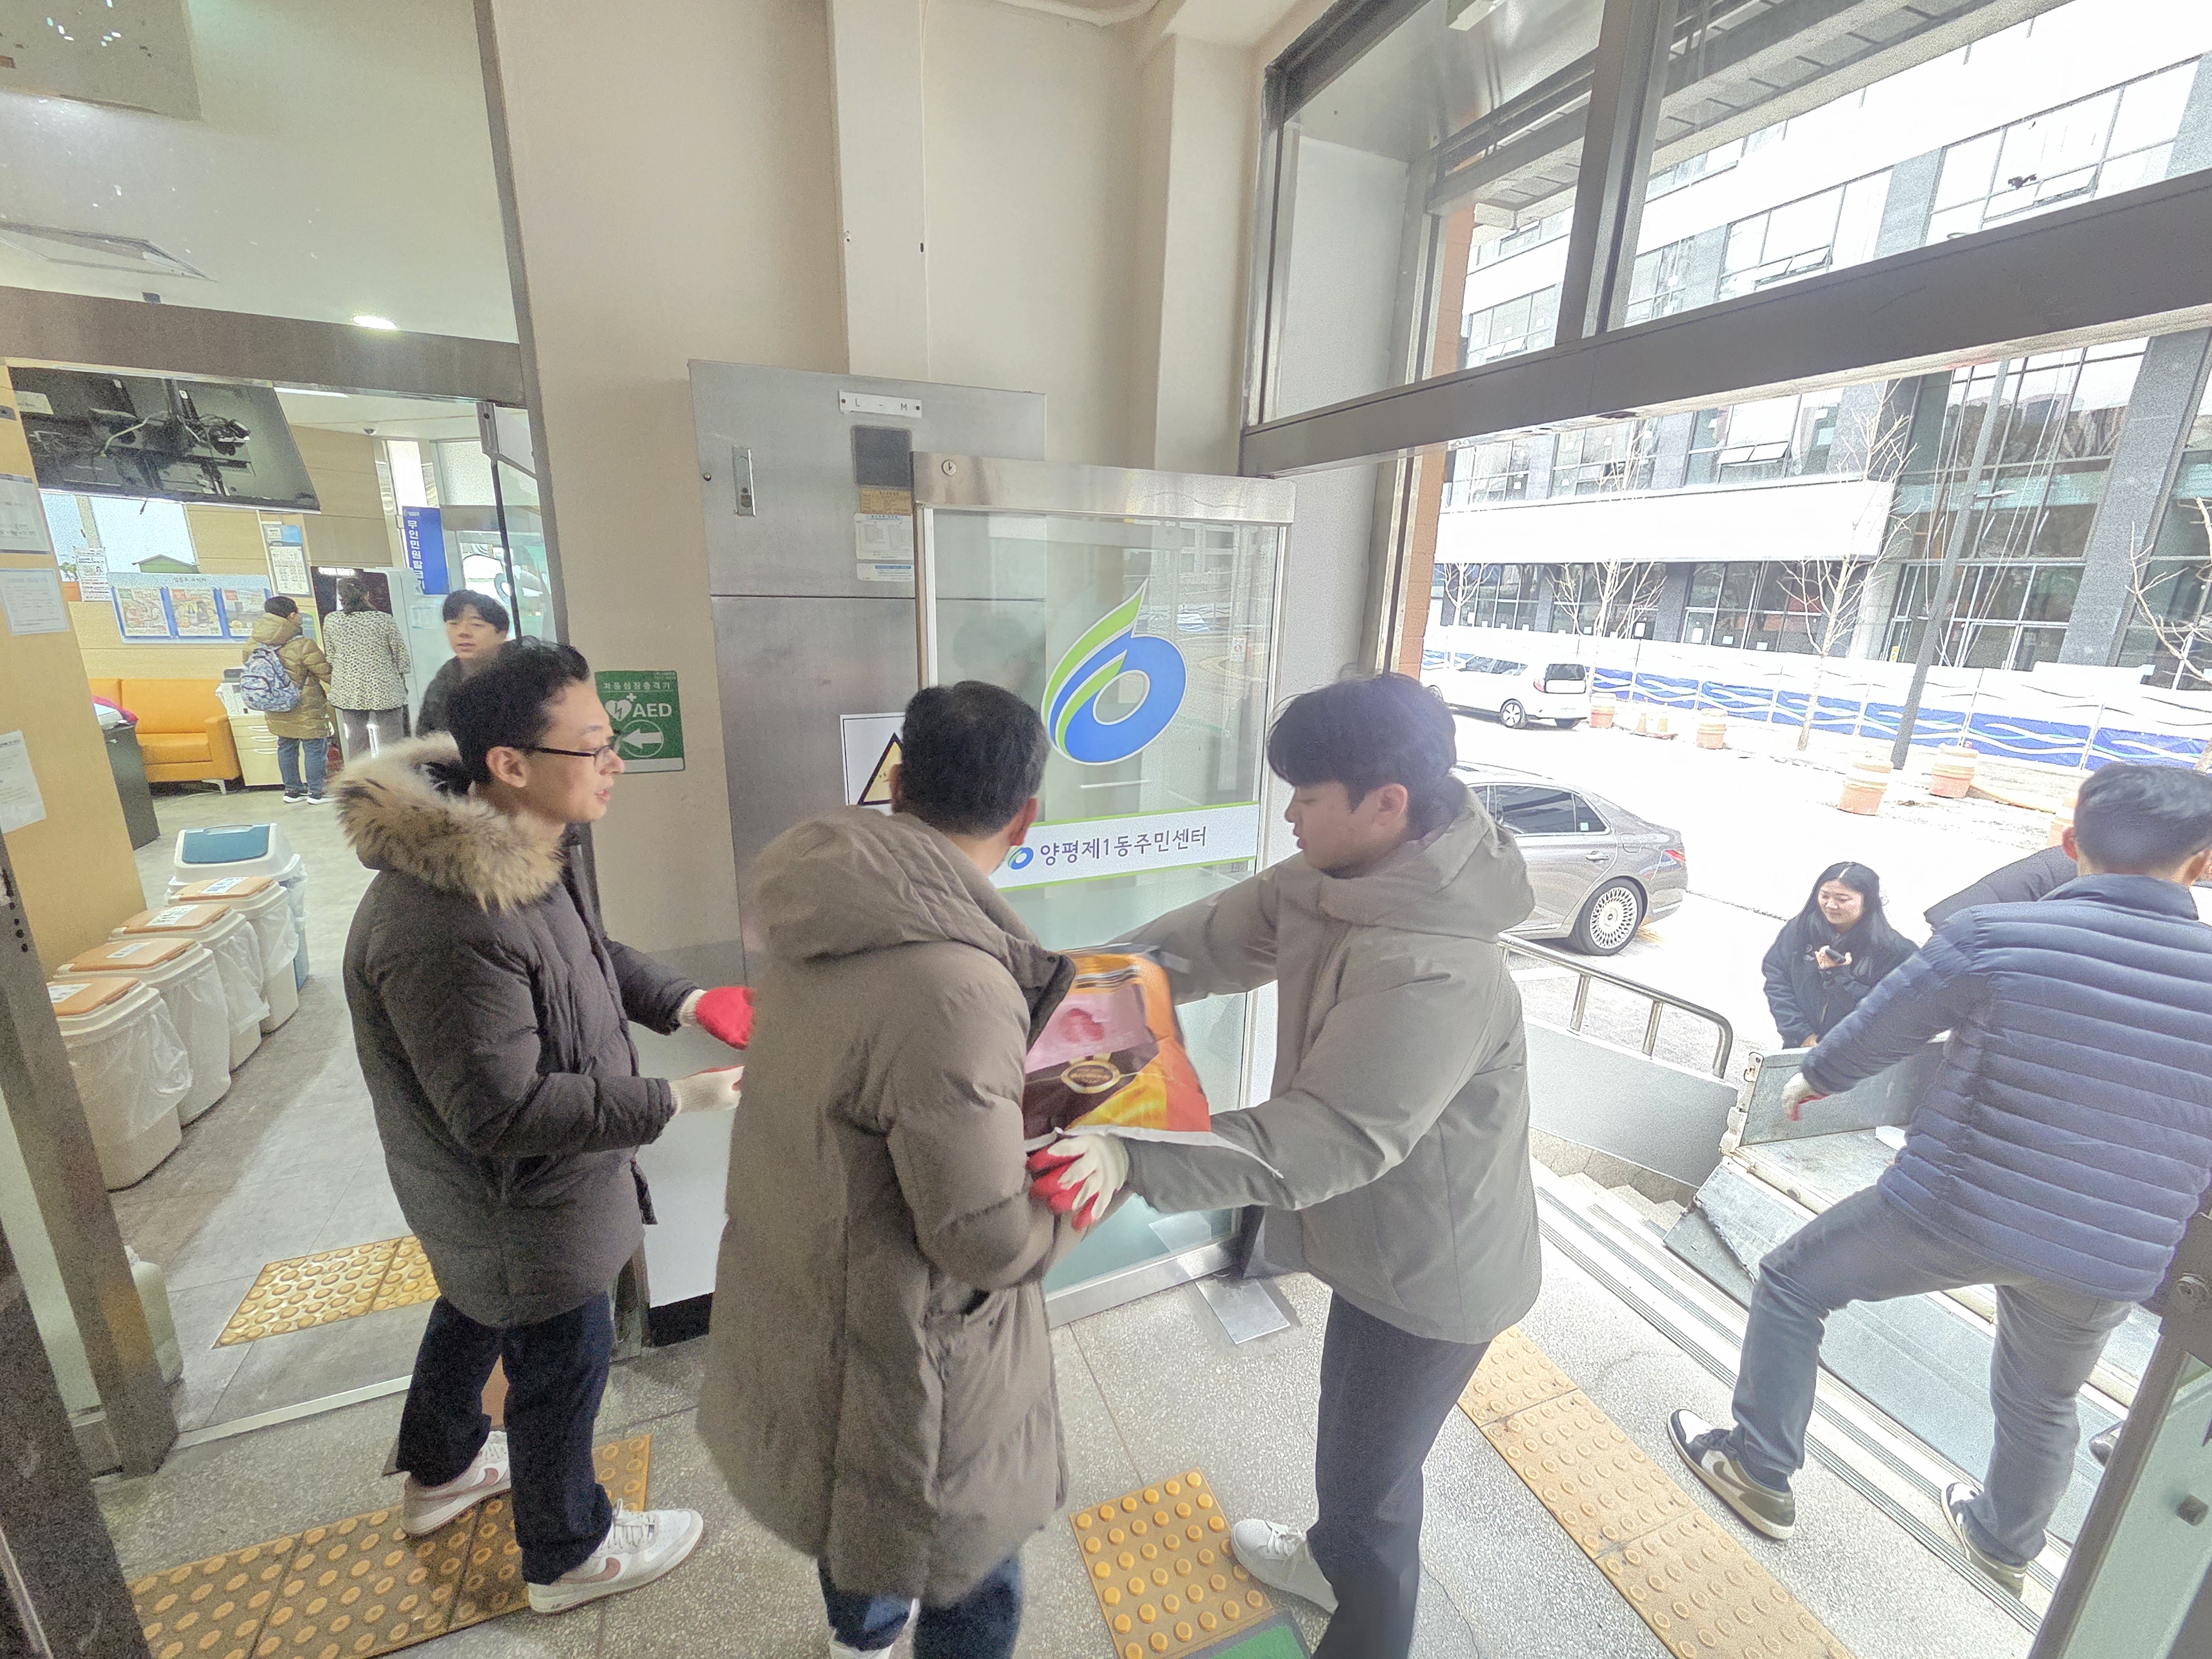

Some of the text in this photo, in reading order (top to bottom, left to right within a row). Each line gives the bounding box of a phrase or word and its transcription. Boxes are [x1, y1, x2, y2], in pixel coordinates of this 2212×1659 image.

[855, 398, 860, 407] L
[632, 703, 672, 718] AED
[1040, 826, 1207, 866] 양평제1동주민센터
